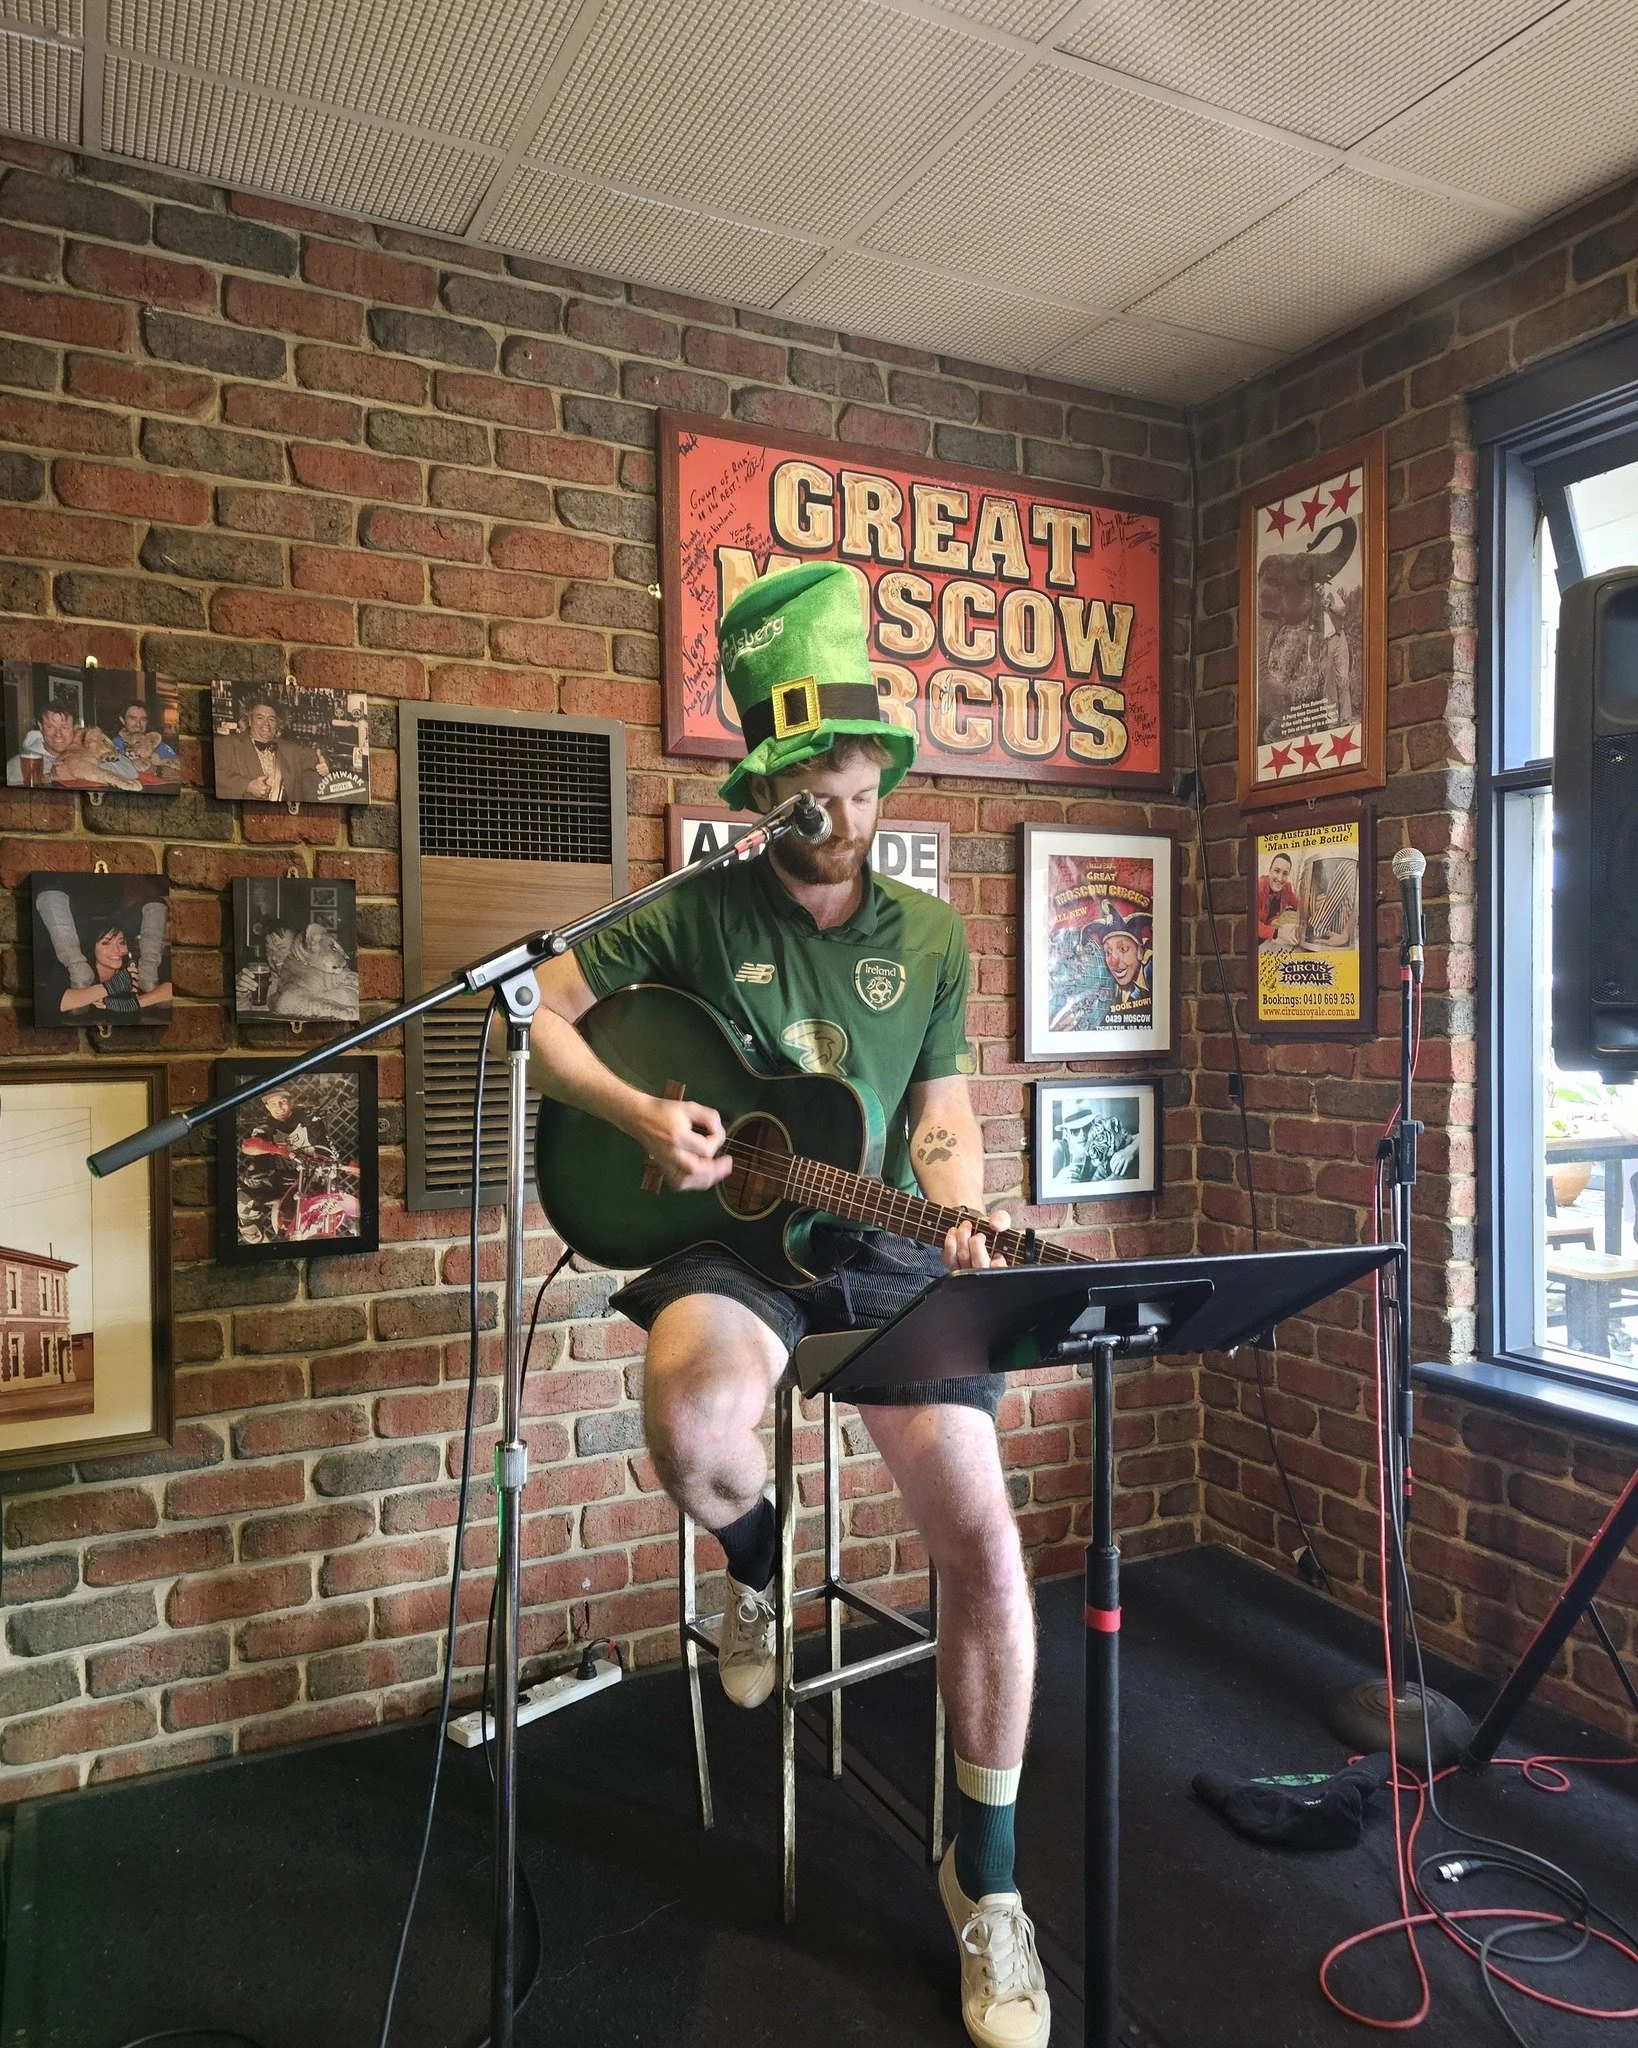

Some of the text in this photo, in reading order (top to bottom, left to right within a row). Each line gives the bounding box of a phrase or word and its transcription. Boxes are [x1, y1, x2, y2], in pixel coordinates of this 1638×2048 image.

[771, 460, 1091, 587] GREAT
[717, 546, 1134, 678] SCOW
[717, 655, 1128, 762] RCUS
[316, 770, 365, 795] SOUTHWARK
[1264, 823, 1352, 842] See Australia's only
[1303, 838, 1317, 847] the
[1087, 871, 1116, 881] GREAT
[1070, 906, 1088, 919] NEW
[865, 963, 897, 977] Ireland
[1285, 964, 1327, 974] CIRCUS
[1284, 973, 1329, 981] ROYALE
[1110, 1001, 1132, 1012] BOOK
[1263, 993, 1355, 1007] Bookings: 0410 669 253
[1105, 1014, 1151, 1023] 0429 MOSCOW
[1263, 1007, 1356, 1018] www.circusroyale.com.au
